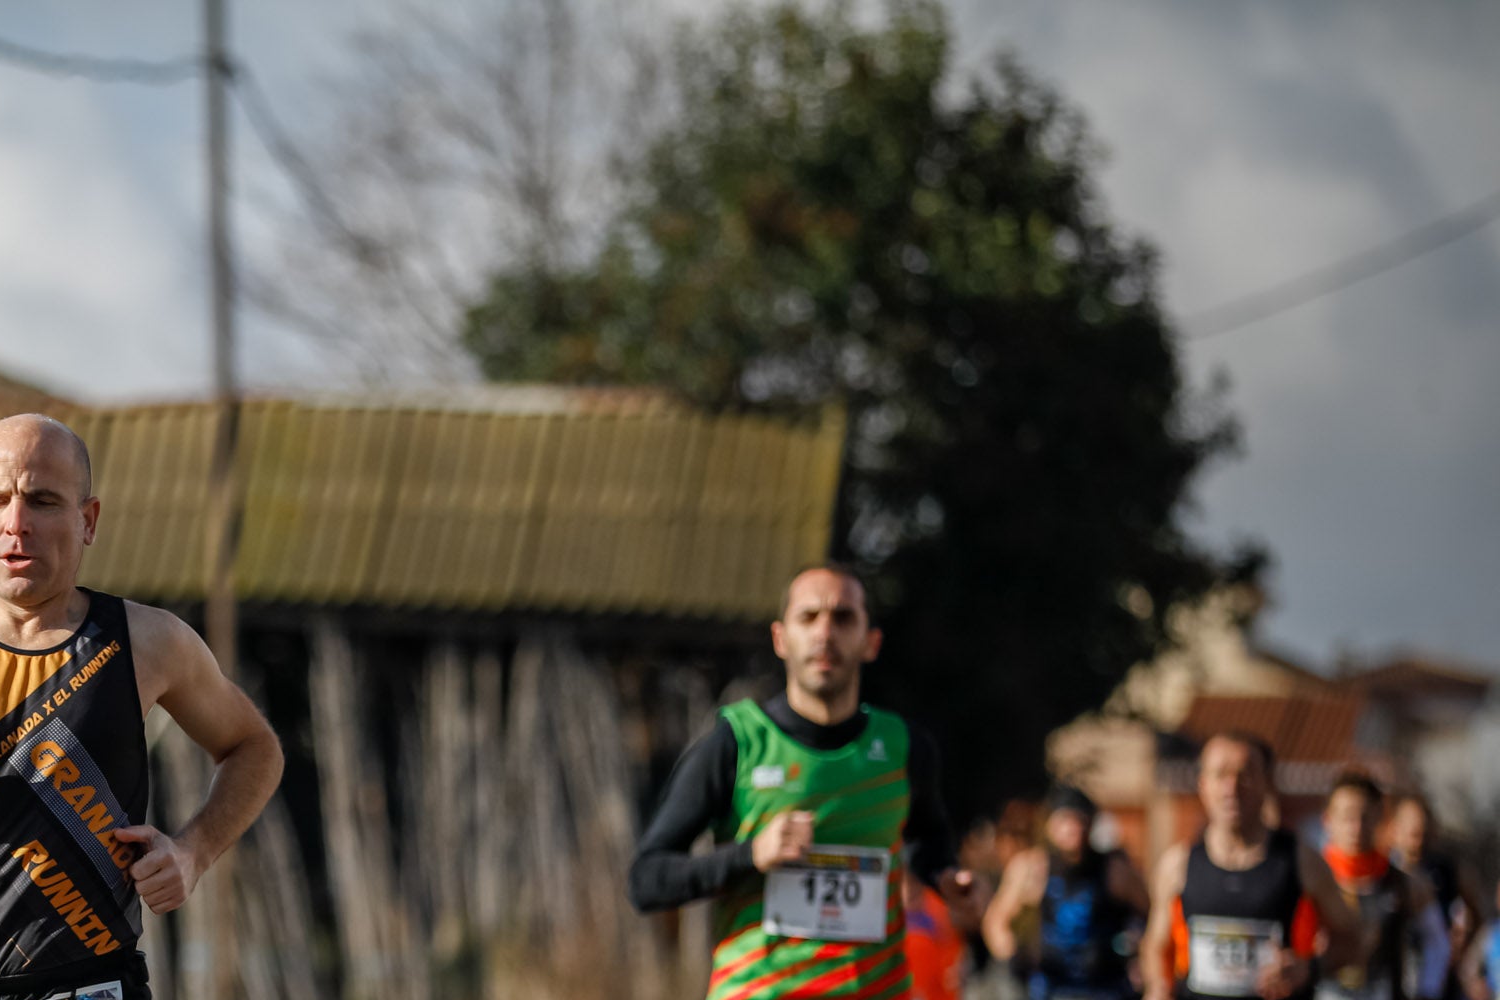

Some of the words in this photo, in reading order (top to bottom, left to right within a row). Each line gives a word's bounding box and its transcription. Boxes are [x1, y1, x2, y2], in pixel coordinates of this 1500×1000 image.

[42, 702, 55, 717] X
[54, 688, 72, 707] EL
[68, 640, 122, 690] RUNNING
[800, 872, 863, 905] 120
